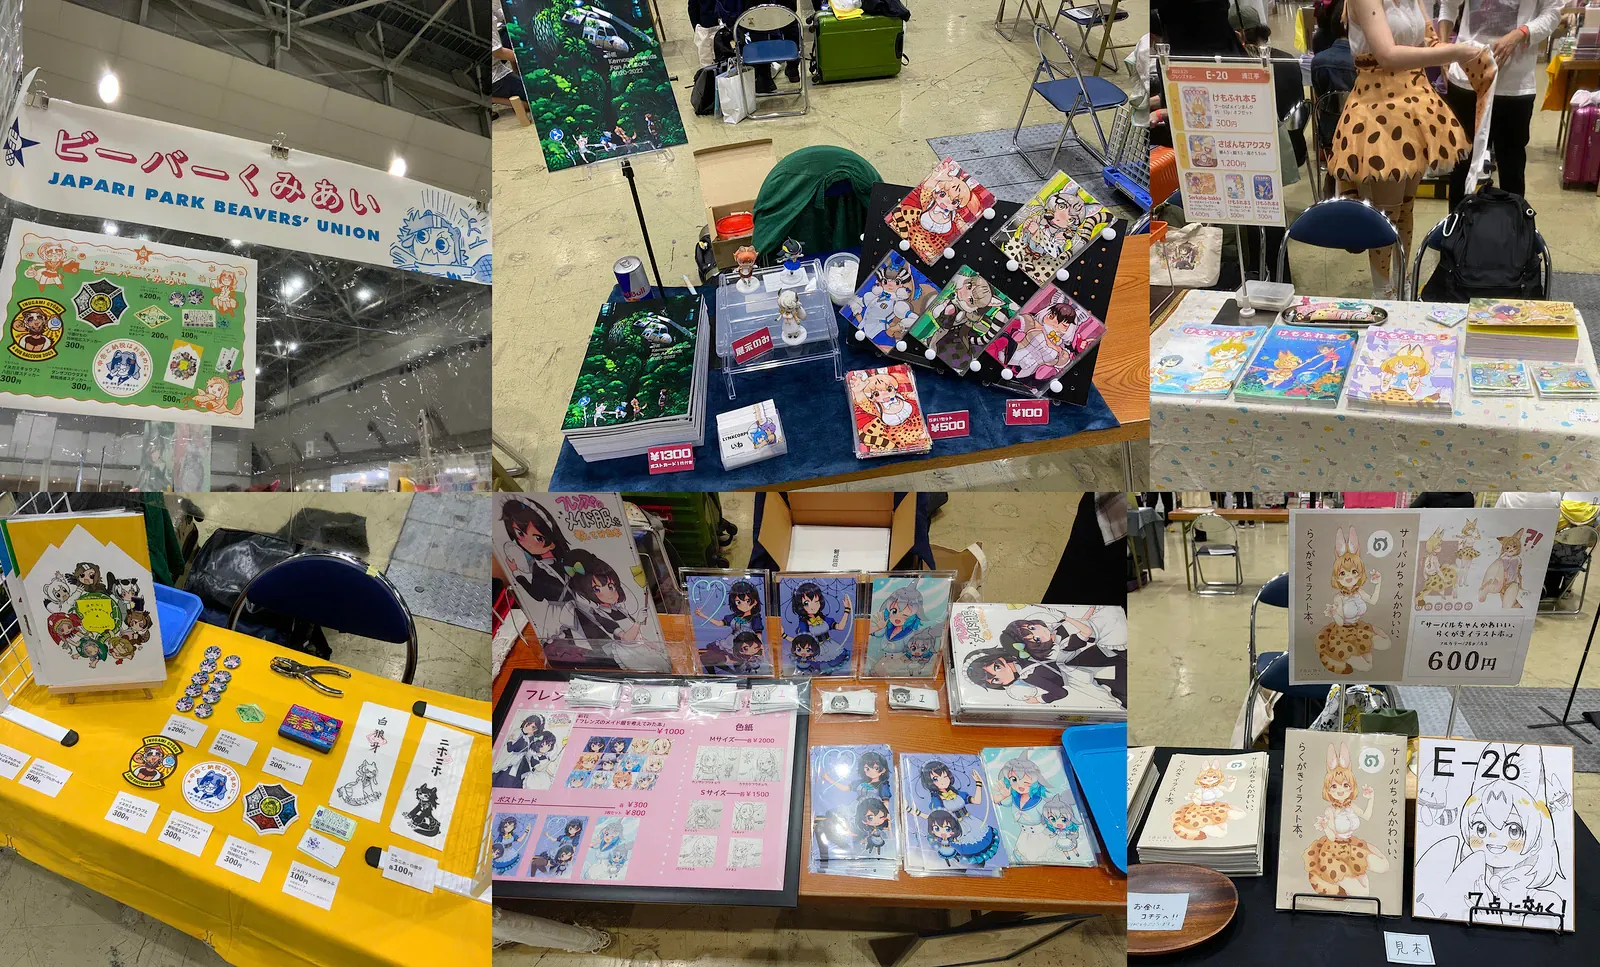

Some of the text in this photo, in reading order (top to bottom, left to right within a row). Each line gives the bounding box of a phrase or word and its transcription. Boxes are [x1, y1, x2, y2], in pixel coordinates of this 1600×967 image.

[1206, 70, 1229, 80] E-20
[1212, 93, 1257, 103] けもふれ本5
[1216, 119, 1238, 128] 300円
[1218, 140, 1271, 149] さばんなアクスタ
[55, 129, 381, 215] ビーバーくみあい
[48, 172, 135, 197] JAPARI
[145, 188, 205, 209] PARK
[317, 219, 380, 242] UNION
[93, 265, 187, 286] ビーバーくみあい
[170, 270, 187, 278] F-14
[151, 331, 169, 340] 200円
[181, 331, 198, 340] 100円
[65, 341, 85, 350] 300円
[735, 334, 770, 357] 展示のみ
[0, 375, 22, 385] 300円
[71, 382, 92, 392] 300円
[162, 395, 181, 403] 500円
[1012, 408, 1043, 418] ¥100
[931, 420, 966, 433] ¥500
[650, 448, 691, 462] ¥1300
[1303, 528, 1410, 639] らくがきイラスト本。 サーバルちゃんかわいい、
[1420, 620, 1515, 629] 『サーバルちゃんかわいい、
[1428, 650, 1497, 671] 600円
[735, 723, 754, 732] 色紙
[368, 716, 388, 754] 白狼牙
[213, 744, 230, 755] 200円
[431, 739, 450, 777] ニホニホ
[1433, 747, 1521, 781] E-26
[269, 760, 286, 772] 200円
[25, 773, 42, 785] 500円
[700, 789, 727, 797] Sサイズ
[497, 796, 537, 804] ポストカード
[1292, 742, 1400, 860] らくがきイラスト本。 サーバルちゃんかわいい、
[112, 809, 129, 822] 300円
[163, 829, 182, 842] 300円
[223, 855, 243, 869] 300円
[388, 864, 413, 878] 各100円
[289, 871, 309, 885] 100円
[1133, 903, 1165, 911] お金は、
[1395, 941, 1425, 956] 見本
